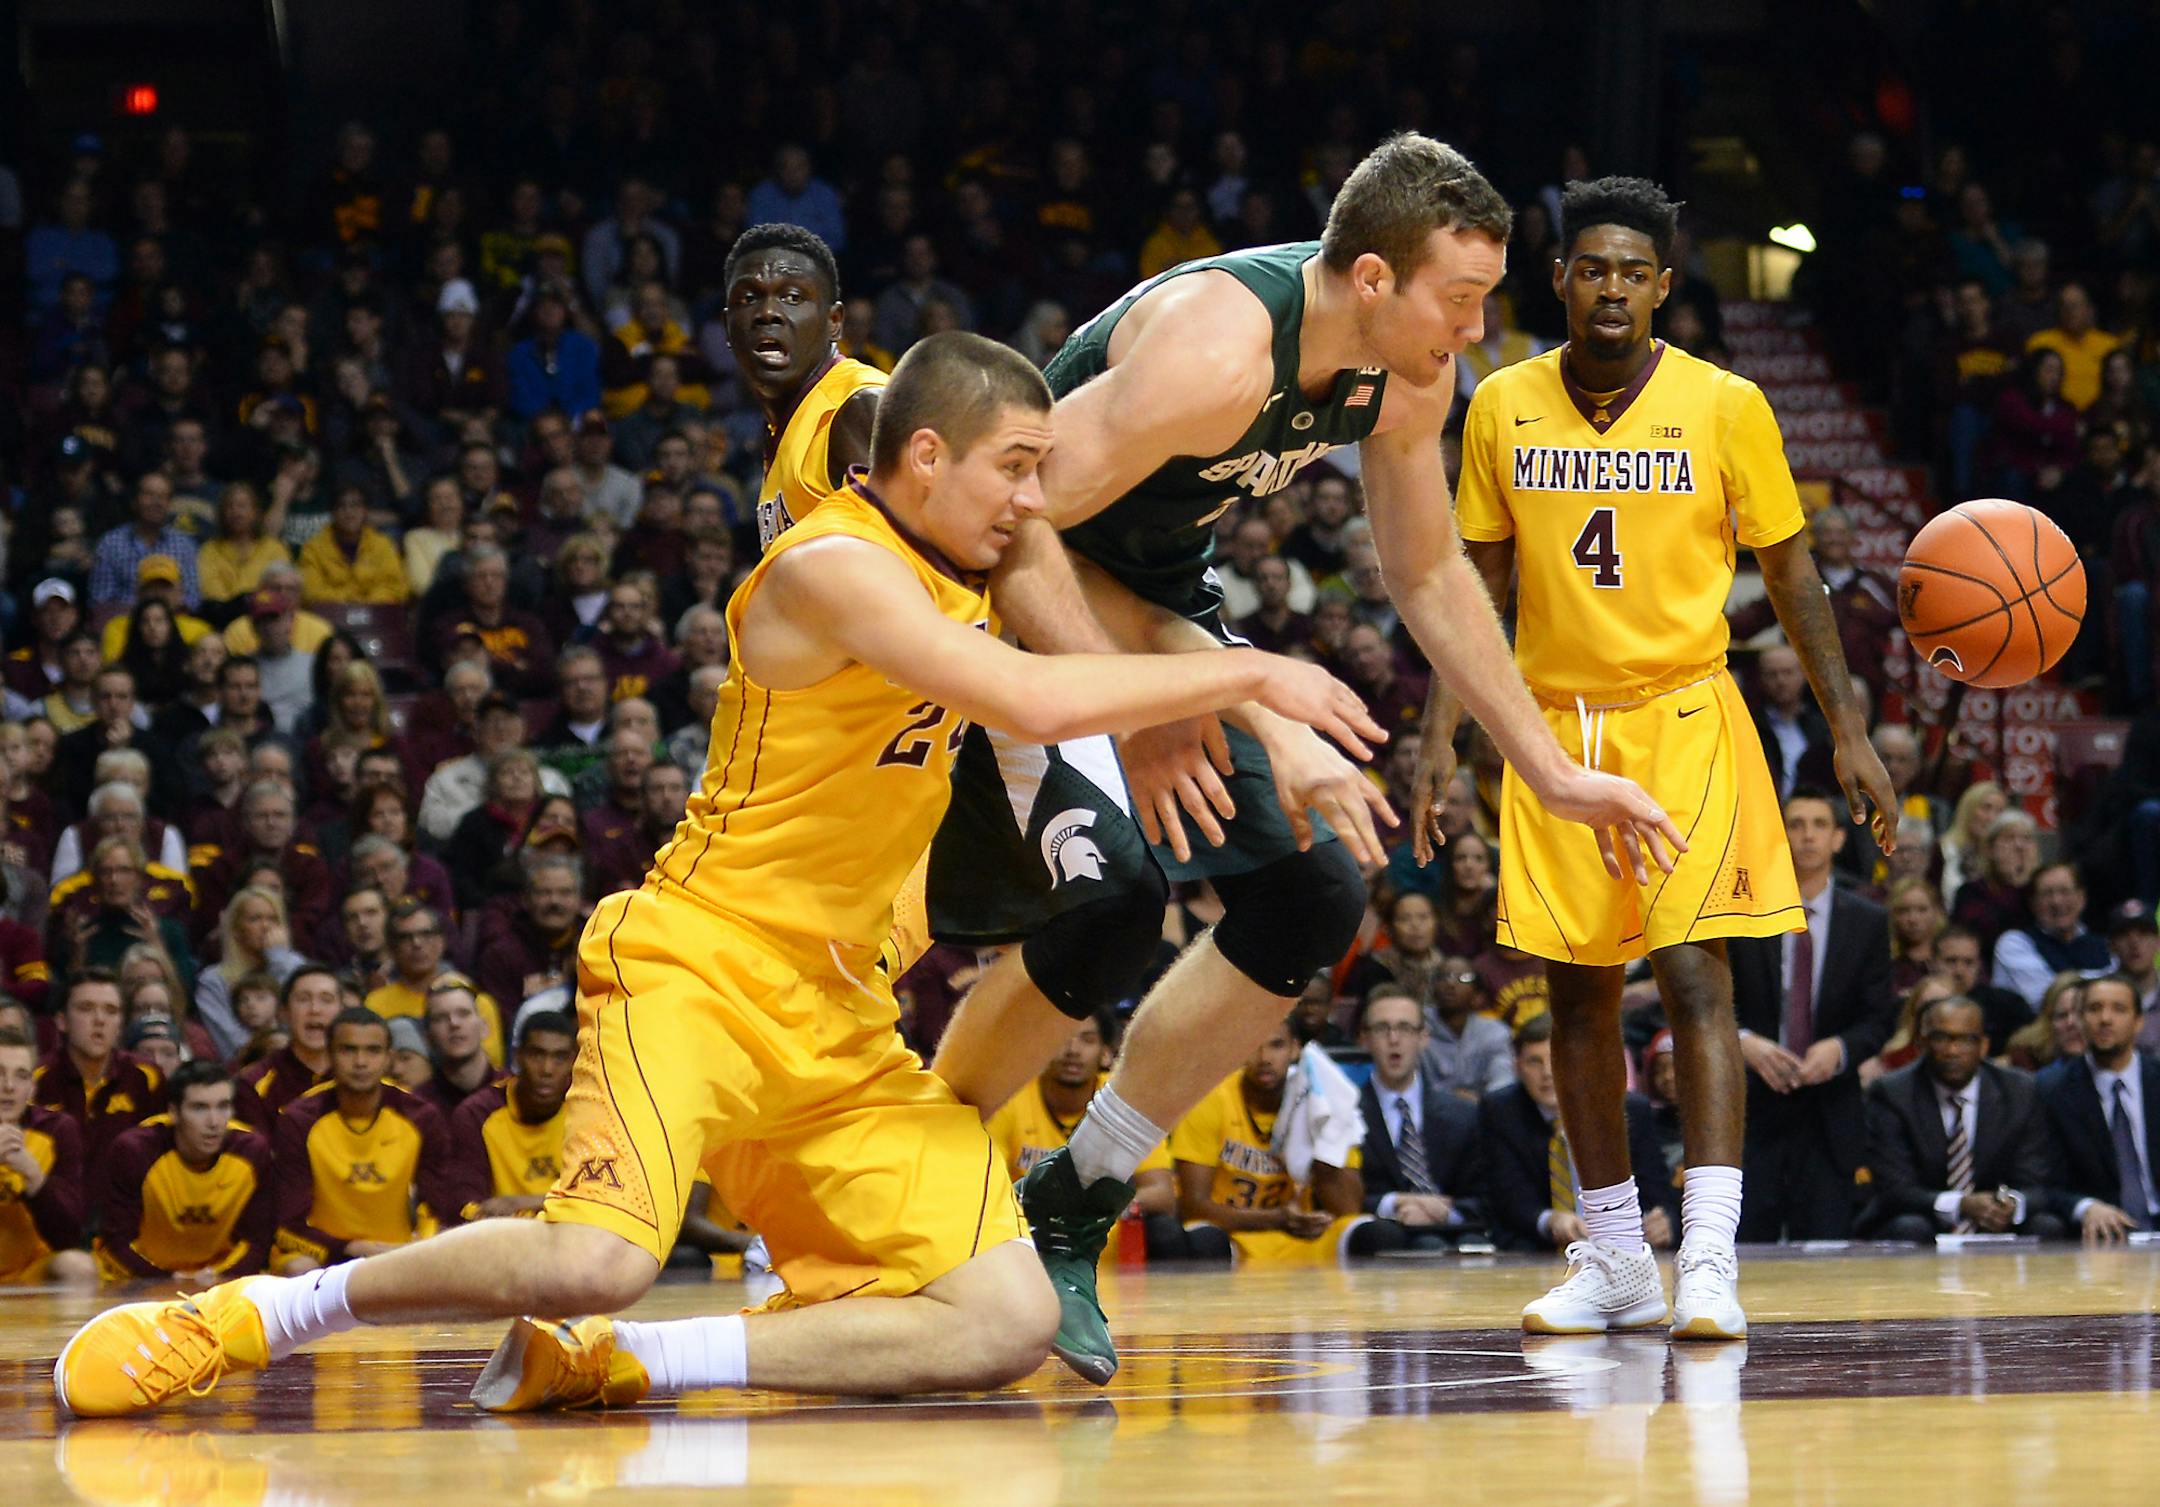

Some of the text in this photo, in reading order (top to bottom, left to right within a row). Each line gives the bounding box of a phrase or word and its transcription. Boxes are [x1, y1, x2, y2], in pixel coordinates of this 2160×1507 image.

[1513, 446, 1696, 494] MINNESOTA
[1571, 507, 1623, 588] 4
[567, 1157, 624, 1191] M
